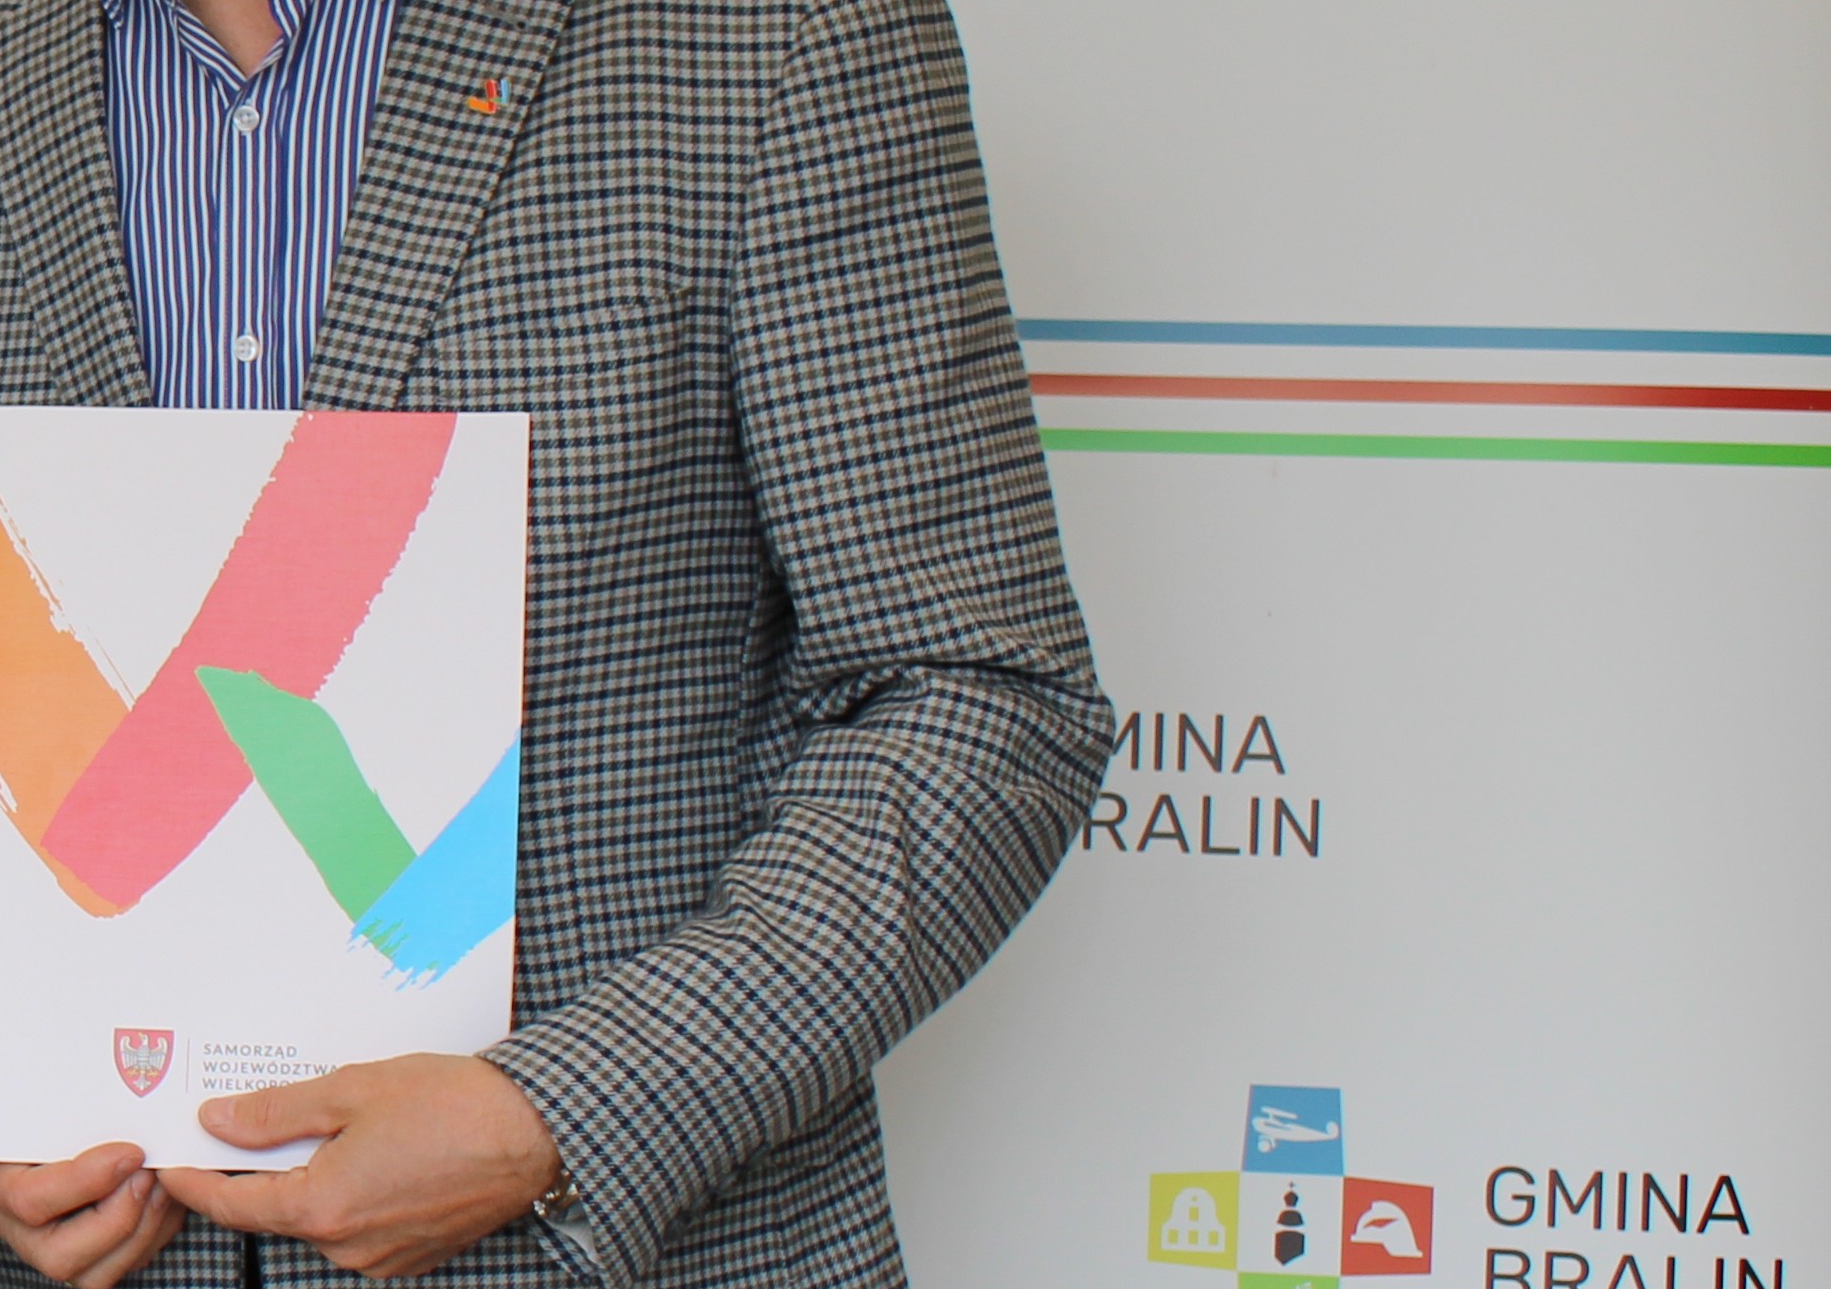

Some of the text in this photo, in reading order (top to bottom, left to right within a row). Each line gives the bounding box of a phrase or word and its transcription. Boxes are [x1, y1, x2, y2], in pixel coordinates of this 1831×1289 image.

[1082, 791, 1321, 859] RALIN
[202, 1042, 298, 1060] SAMORZĄD
[1485, 1166, 1751, 1237] GMINA
